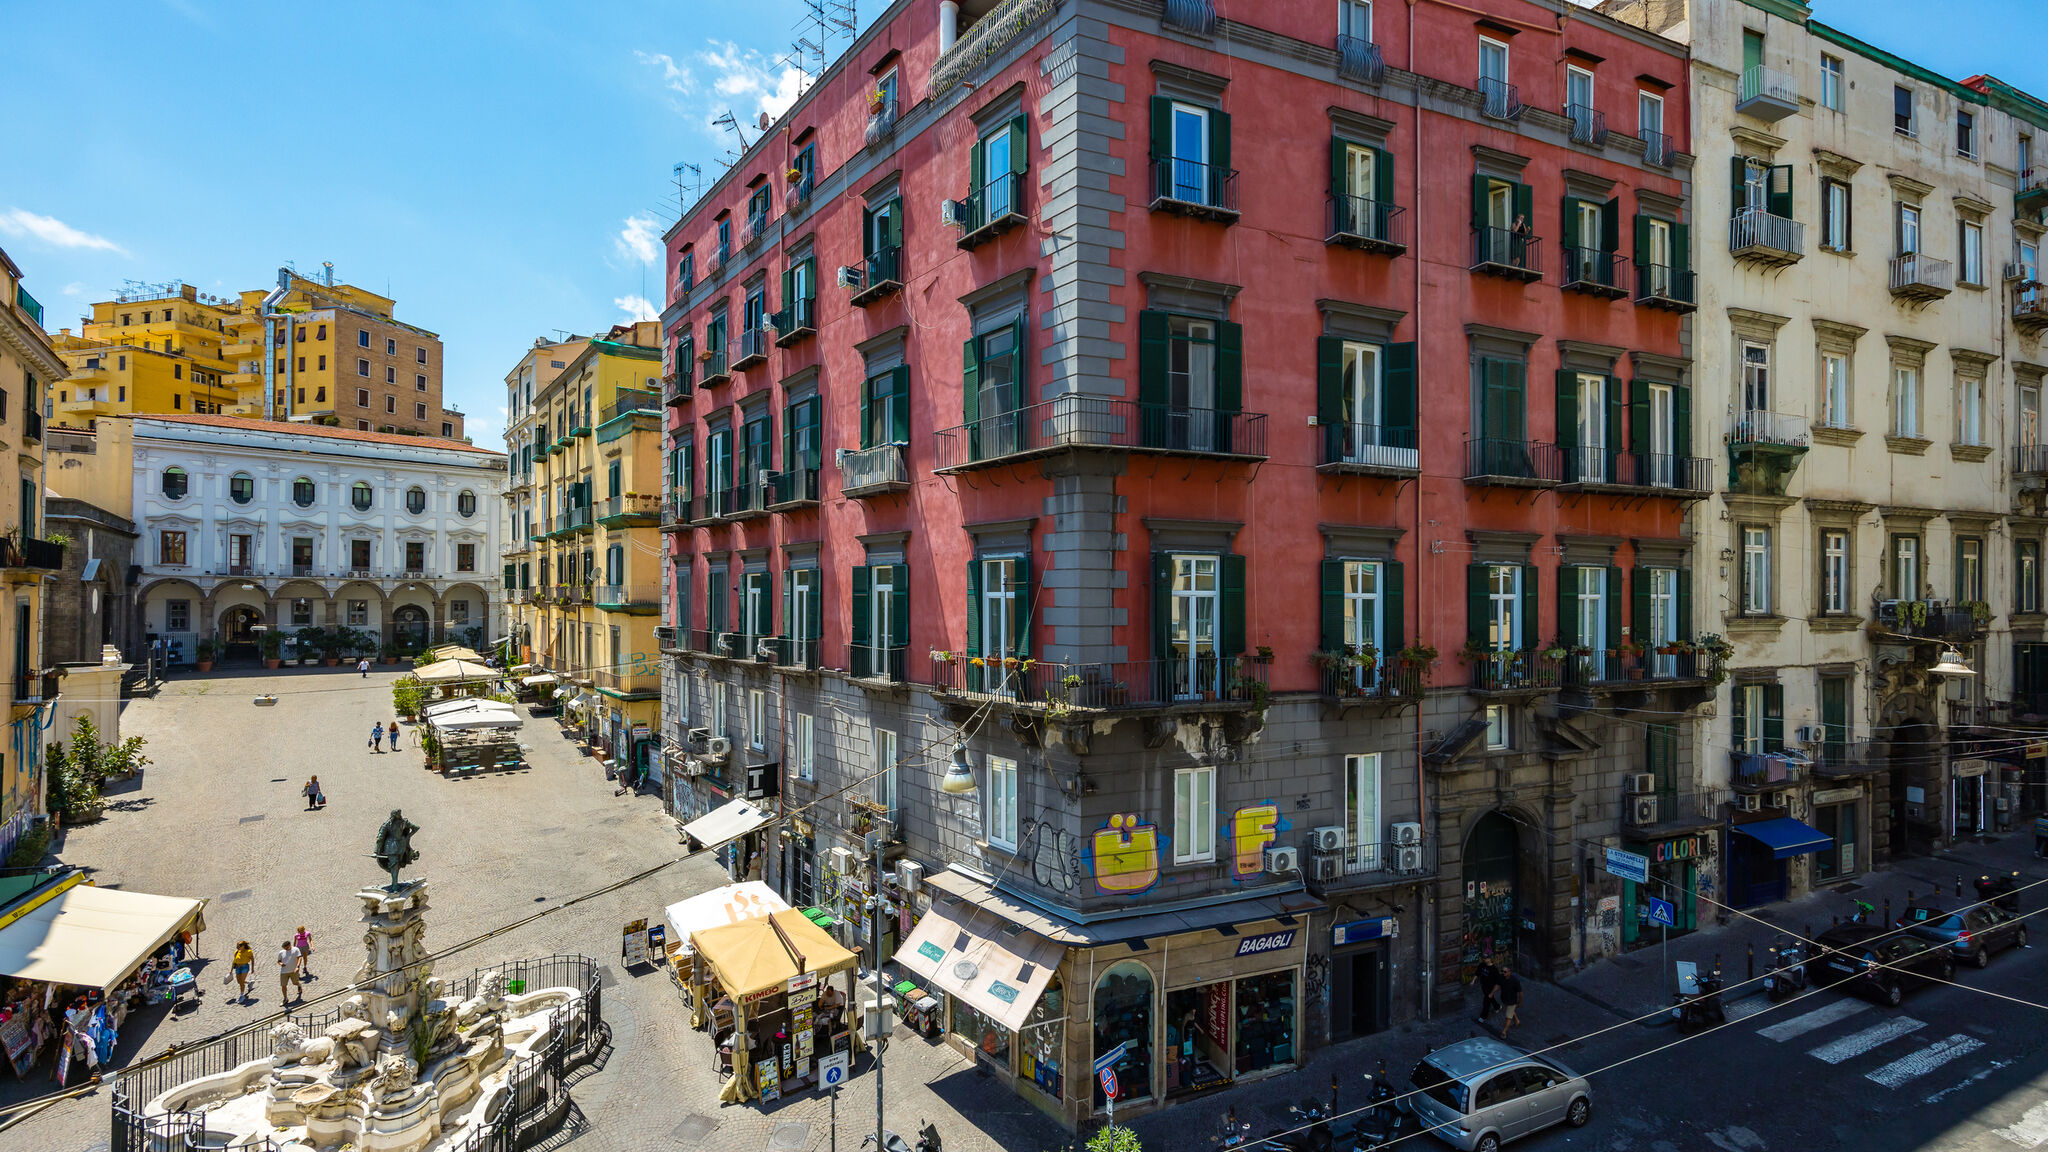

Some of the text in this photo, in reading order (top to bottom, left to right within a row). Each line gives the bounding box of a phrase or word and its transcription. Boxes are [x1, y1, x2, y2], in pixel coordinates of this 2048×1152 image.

[1614, 851, 1644, 864] STEFANELLI
[1656, 837, 1701, 862] COLORI
[1239, 933, 1293, 954] BAGAGLI
[792, 978, 812, 988] KIMBO
[744, 986, 780, 1003] KIMBO
